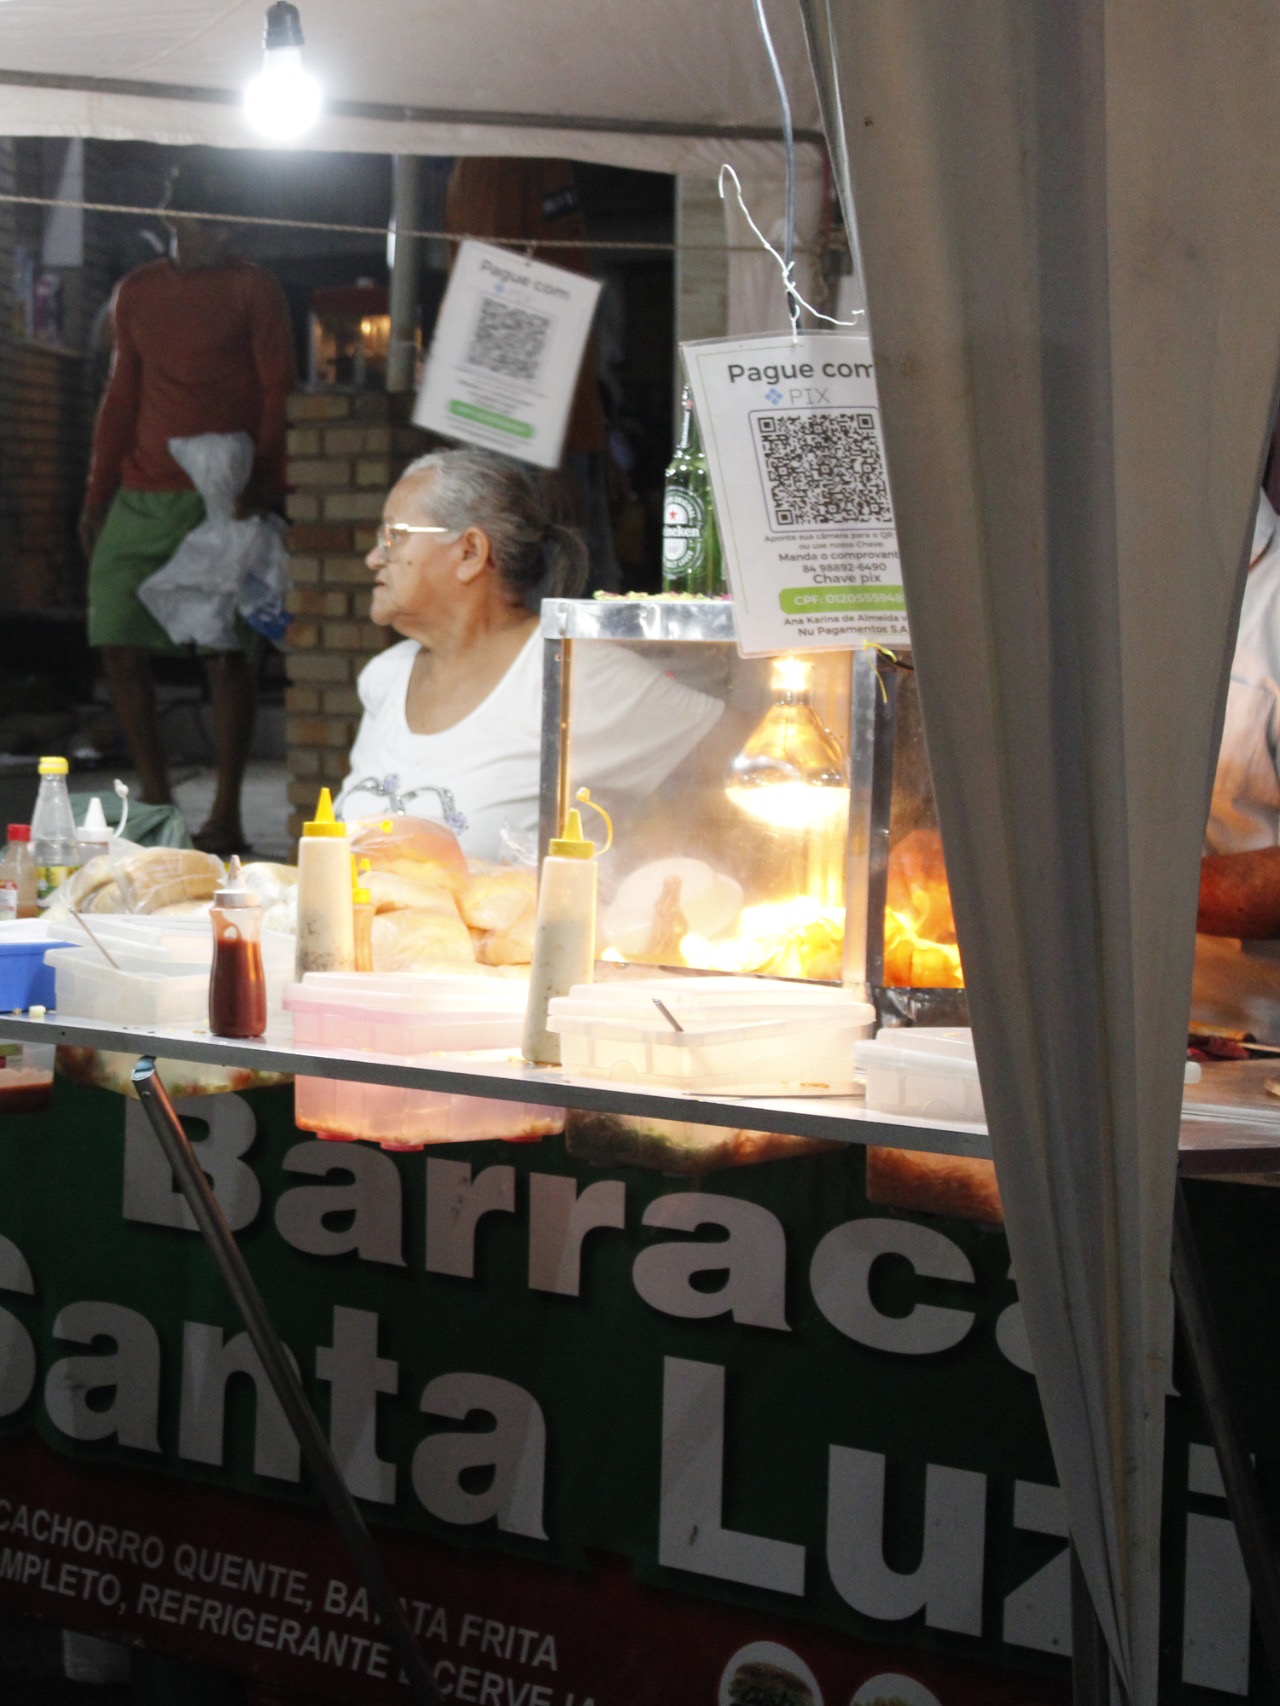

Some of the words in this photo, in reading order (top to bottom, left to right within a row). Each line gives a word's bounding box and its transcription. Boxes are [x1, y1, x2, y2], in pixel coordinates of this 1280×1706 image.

[480, 258, 532, 287] Pague
[534, 279, 570, 301] com
[727, 362, 814, 385] Pague
[788, 388, 831, 405] PIX
[764, 534, 797, 543] Aponte
[816, 531, 849, 541] câmera
[850, 532, 870, 542] para
[880, 531, 894, 539] QR
[778, 552, 818, 562] Manda
[820, 553, 828, 561] o
[802, 564, 816, 573] 84
[819, 562, 887, 573] 98892-6490
[812, 573, 857, 584] Chave
[860, 572, 882, 585] pix
[783, 617, 804, 626] Ana
[806, 615, 839, 625] Karina
[842, 614, 855, 623] de
[857, 613, 899, 622] Almeida
[797, 627, 815, 637] Nu
[817, 625, 888, 636] Pagamentos
[173, 1544, 314, 1614] QUENTE,
[323, 1579, 449, 1644] BATA
[457, 1613, 560, 1672] FRITA
[136, 1582, 392, 1680] REFRIGERANTE
